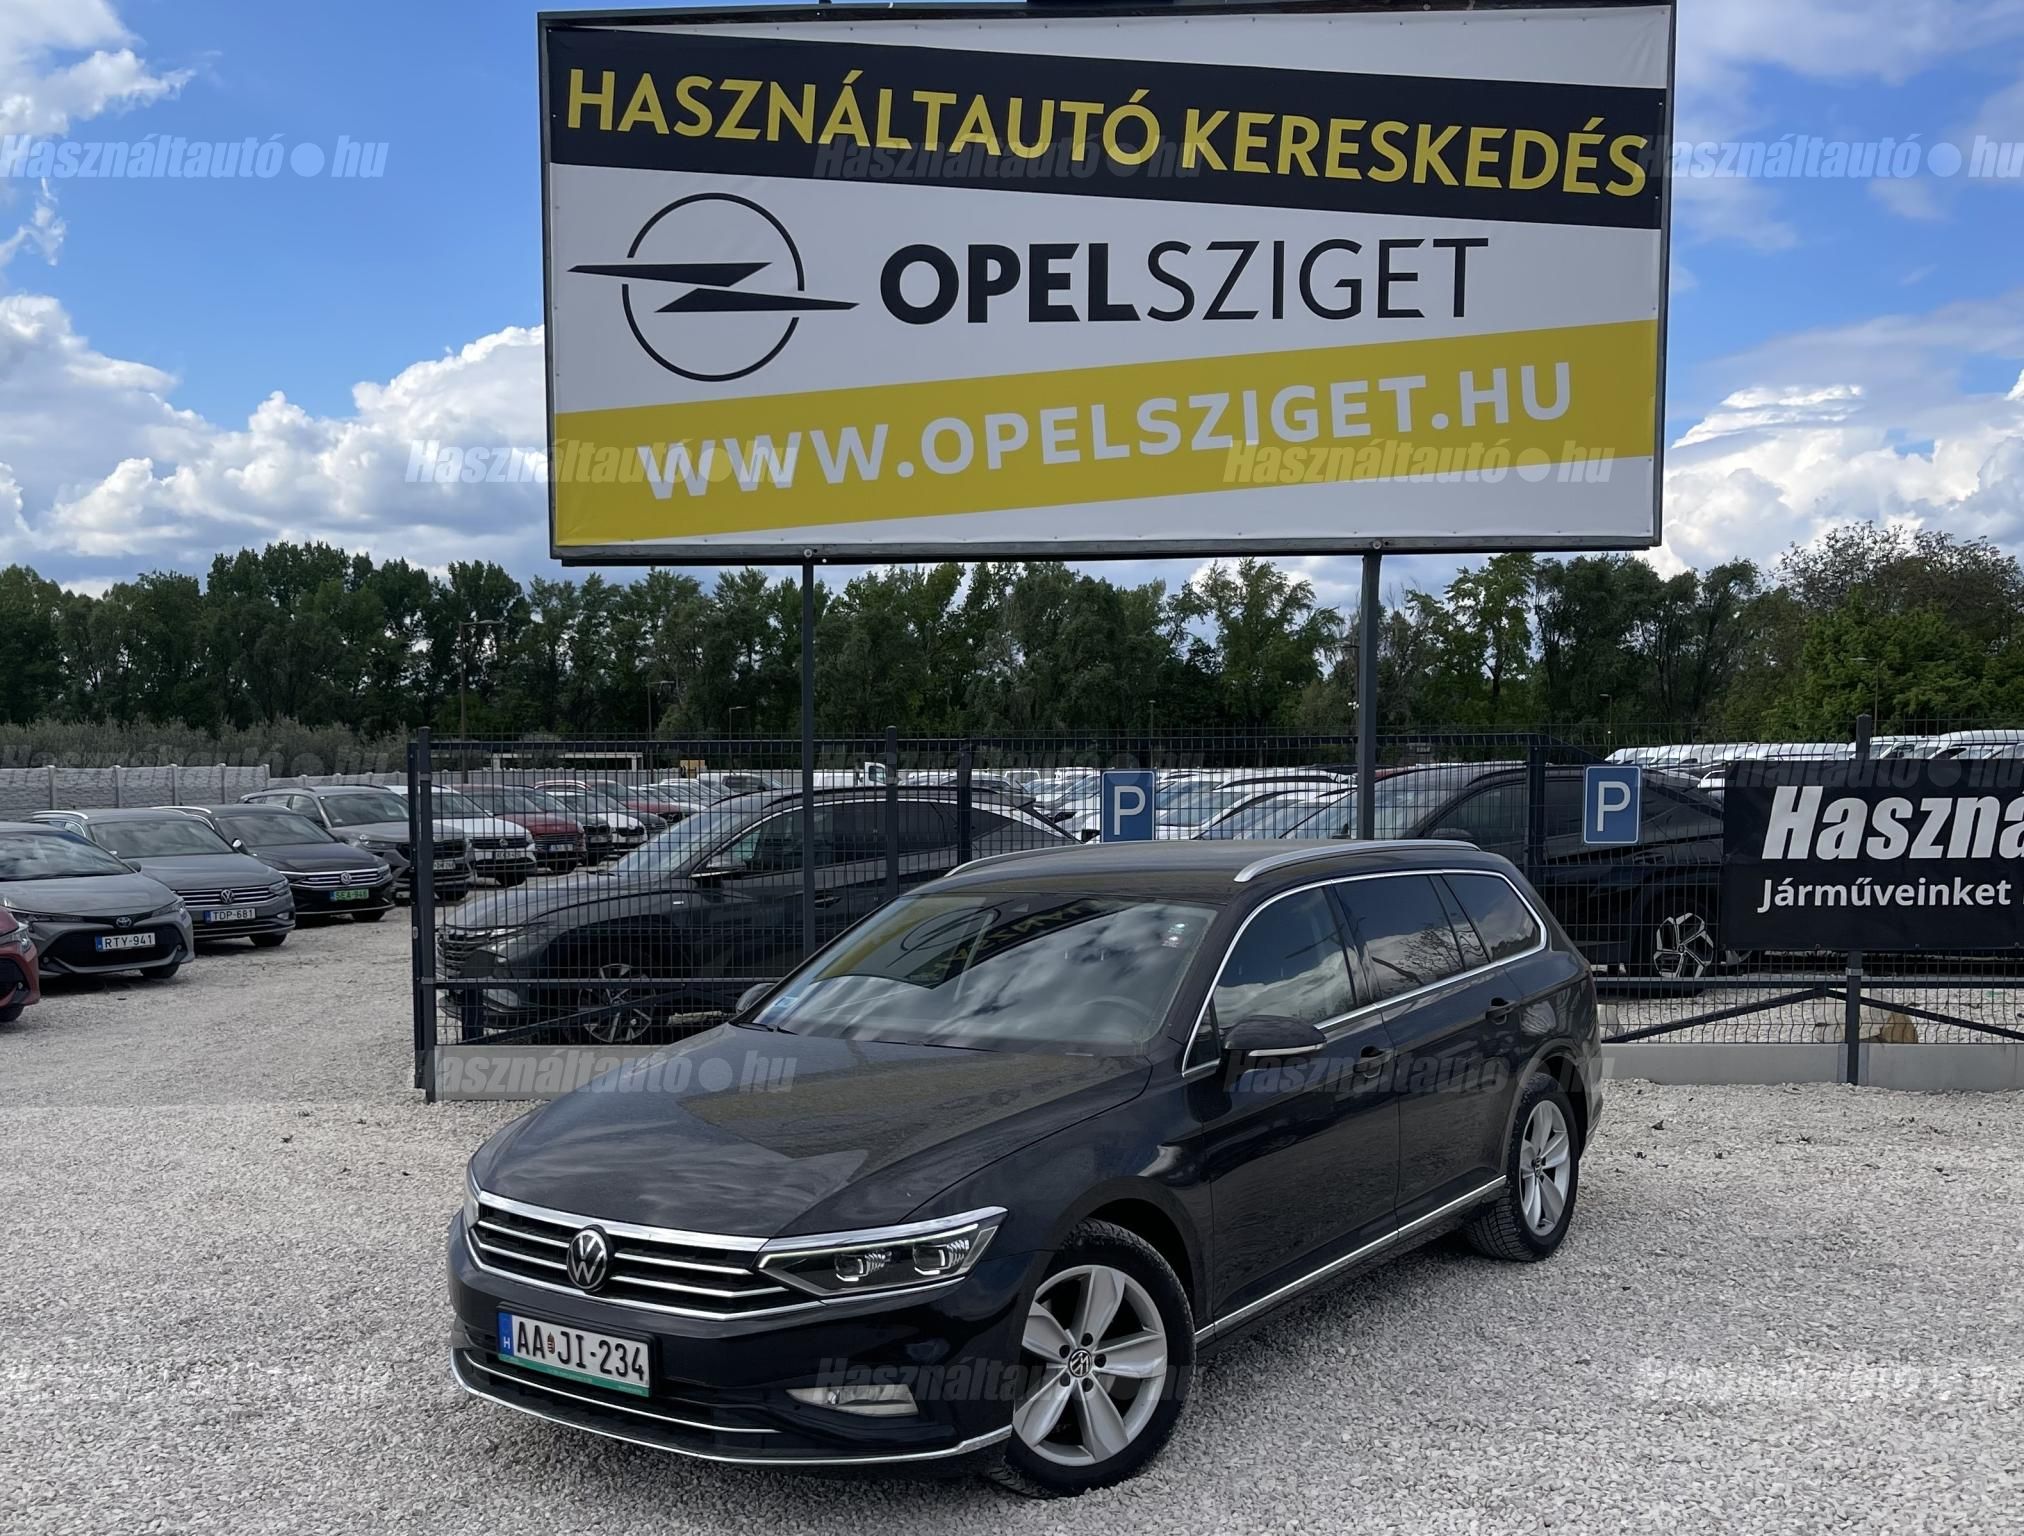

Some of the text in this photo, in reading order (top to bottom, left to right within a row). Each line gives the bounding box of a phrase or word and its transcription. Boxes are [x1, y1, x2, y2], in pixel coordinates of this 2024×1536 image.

[566, 69, 1649, 198] HASZNÁLTAUTÓ KERESKEDÉS
[880, 238, 1489, 325] OPELSZIGET
[637, 361, 1572, 500] WWW.OPELSZIGET.HU
[1113, 785, 1146, 836] P
[1597, 781, 1631, 832] P
[1756, 876, 2012, 914] Járműveinket
[104, 933, 153, 949] RTY-941
